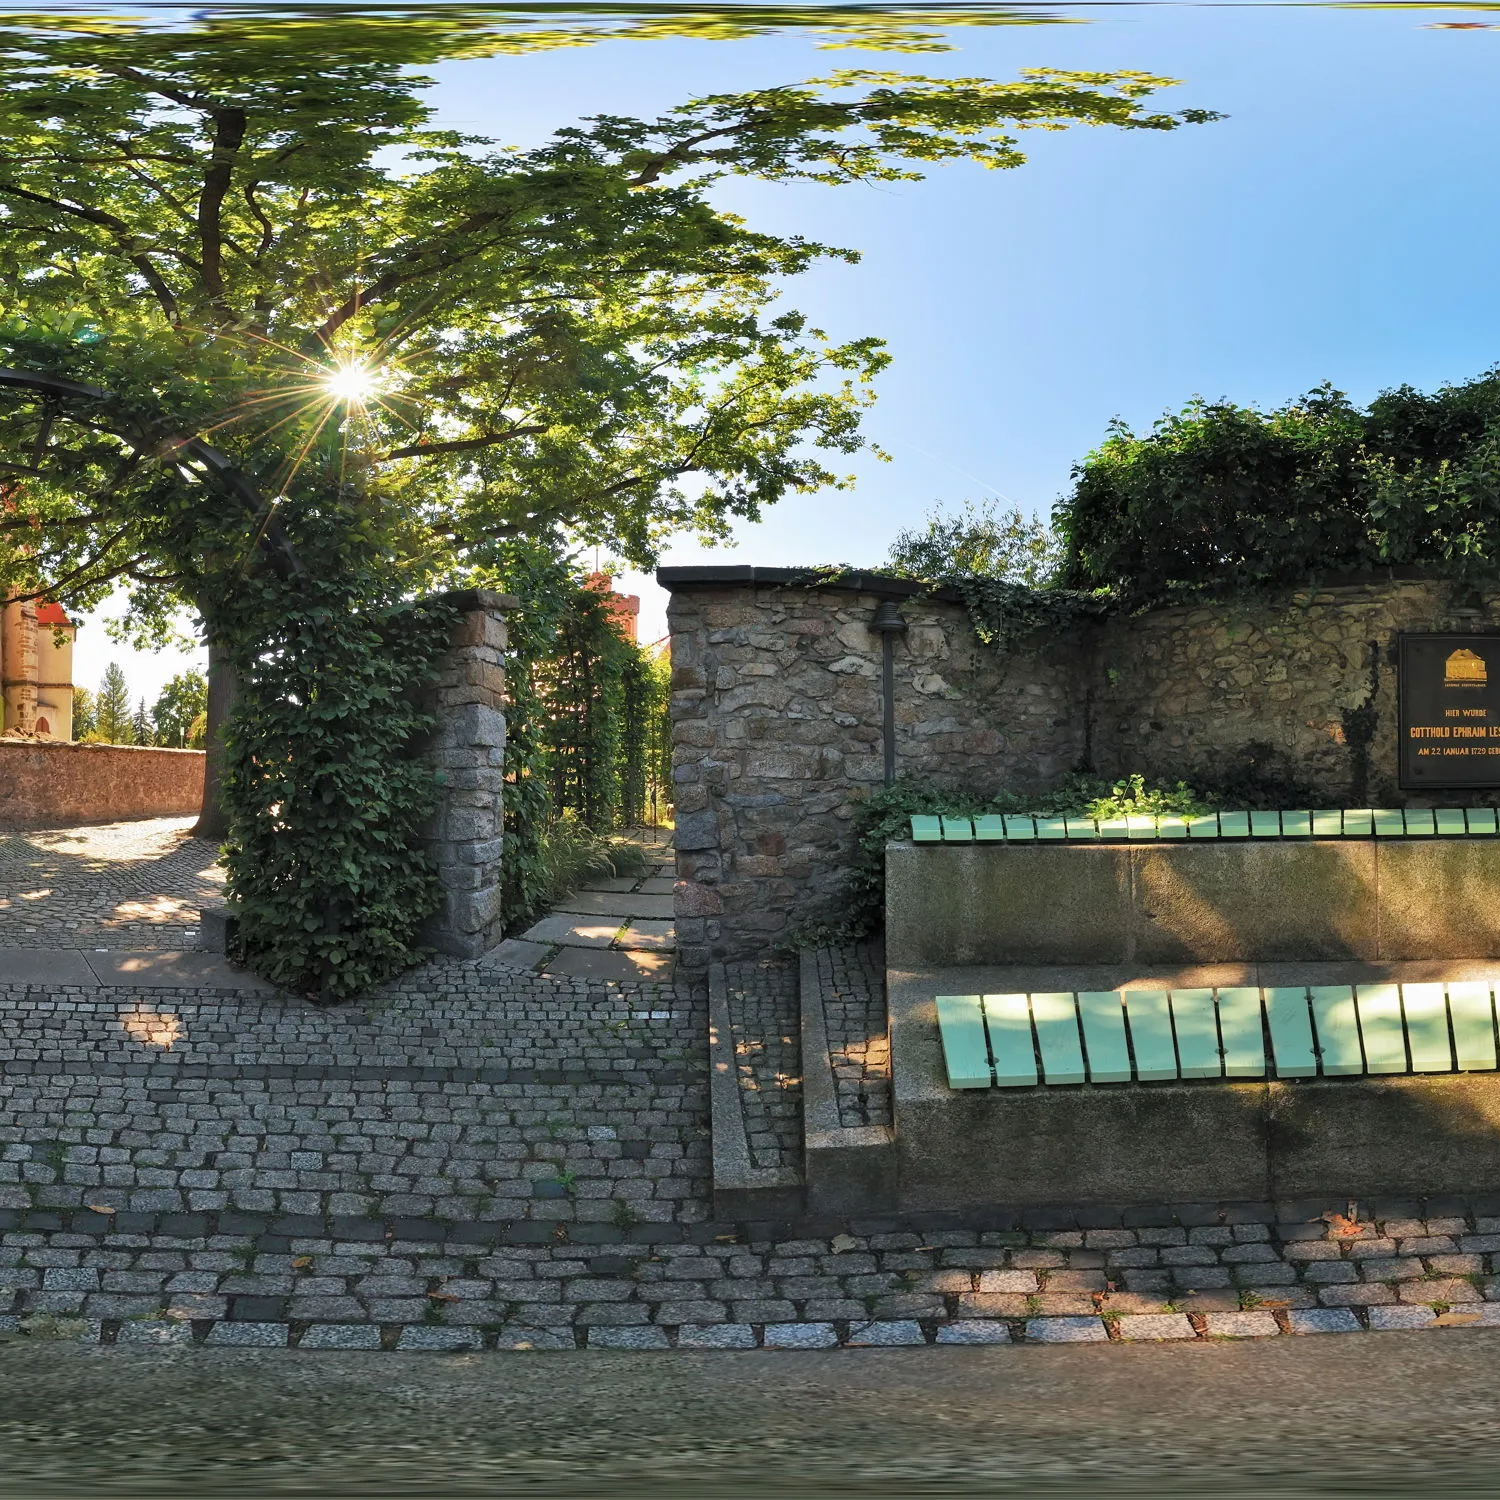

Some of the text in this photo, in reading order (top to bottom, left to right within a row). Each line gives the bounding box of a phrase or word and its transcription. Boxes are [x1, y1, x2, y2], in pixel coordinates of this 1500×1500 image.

[1445, 709, 1487, 717] HIER WURDE
[1410, 727, 1450, 738] GOTTHOLD
[1453, 727, 1486, 738] EPHRAIM
[1418, 748, 1430, 756] AM
[1471, 747, 1487, 756] 1729
